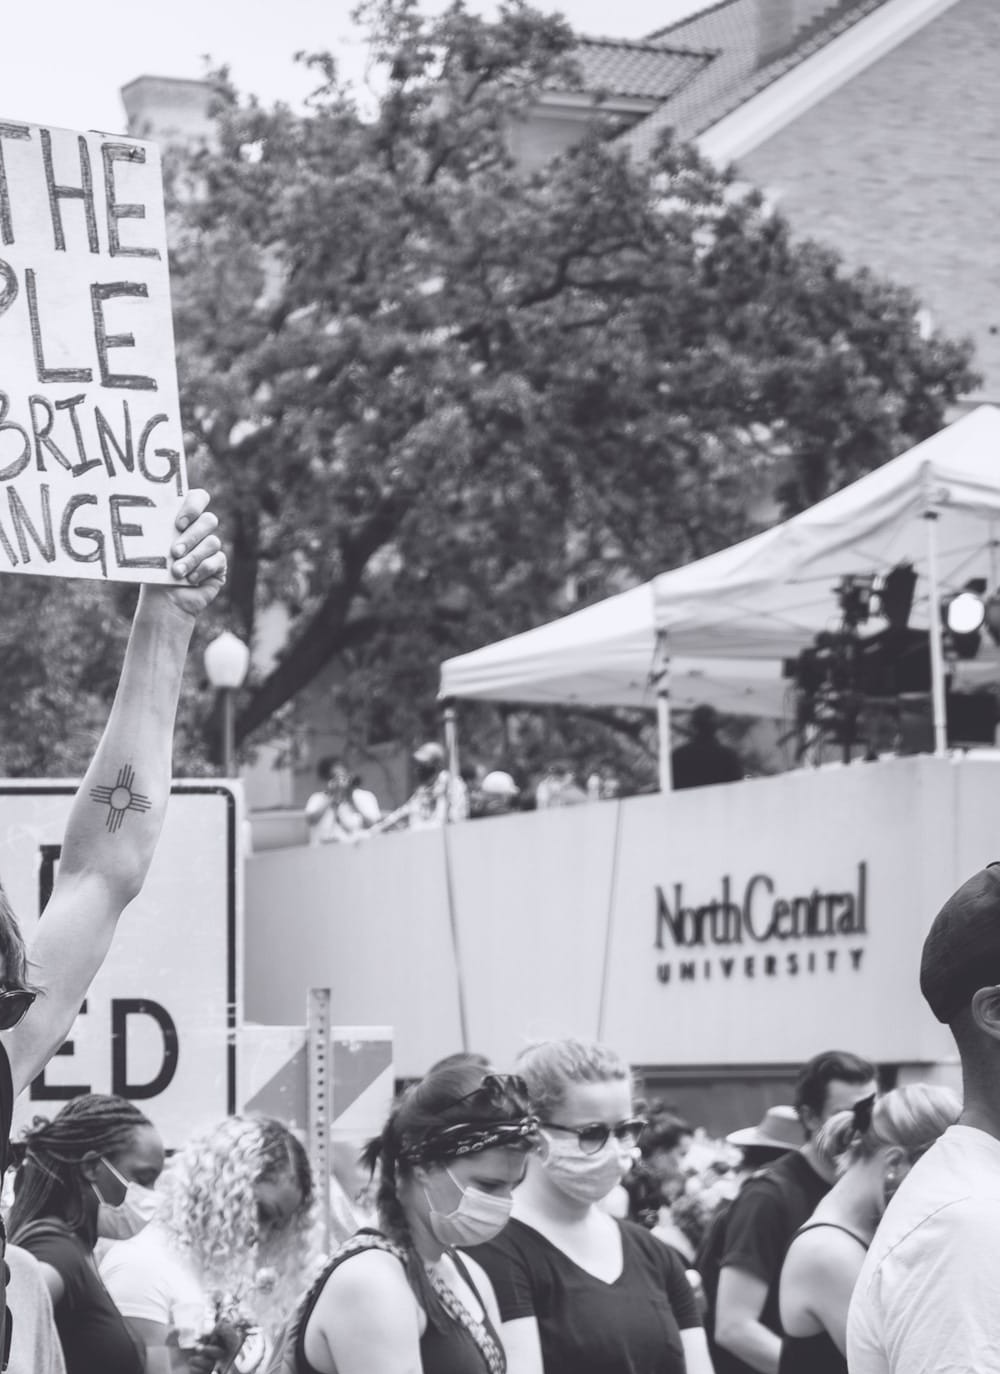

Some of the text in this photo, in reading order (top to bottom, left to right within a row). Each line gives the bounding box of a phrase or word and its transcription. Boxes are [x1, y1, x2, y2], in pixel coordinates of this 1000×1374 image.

[655, 859, 868, 950] North Central
[656, 948, 865, 986] UNIVERSITY
